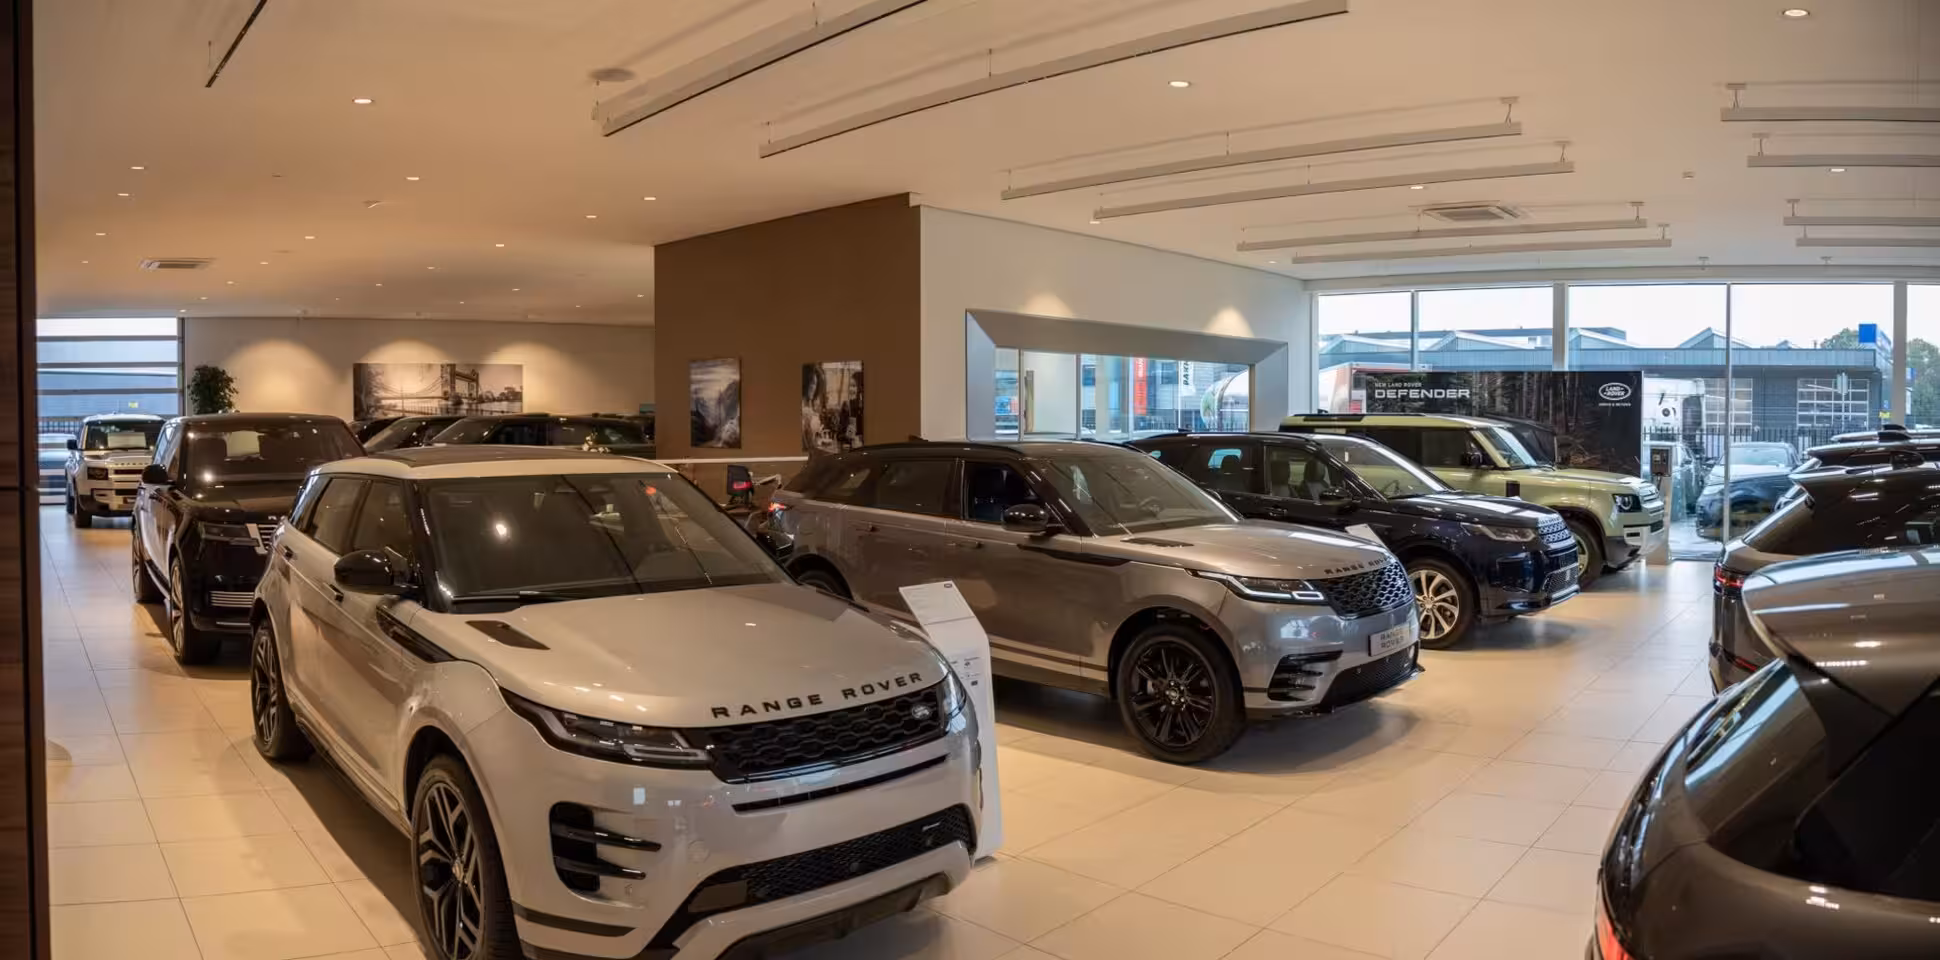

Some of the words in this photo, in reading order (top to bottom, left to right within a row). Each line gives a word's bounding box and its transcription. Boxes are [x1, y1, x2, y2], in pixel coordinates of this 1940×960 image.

[1375, 389, 1470, 399] DEFENDER
[1324, 563, 1365, 575] RANGE
[711, 693, 823, 719] RANGE
[841, 672, 923, 700] ROVER
